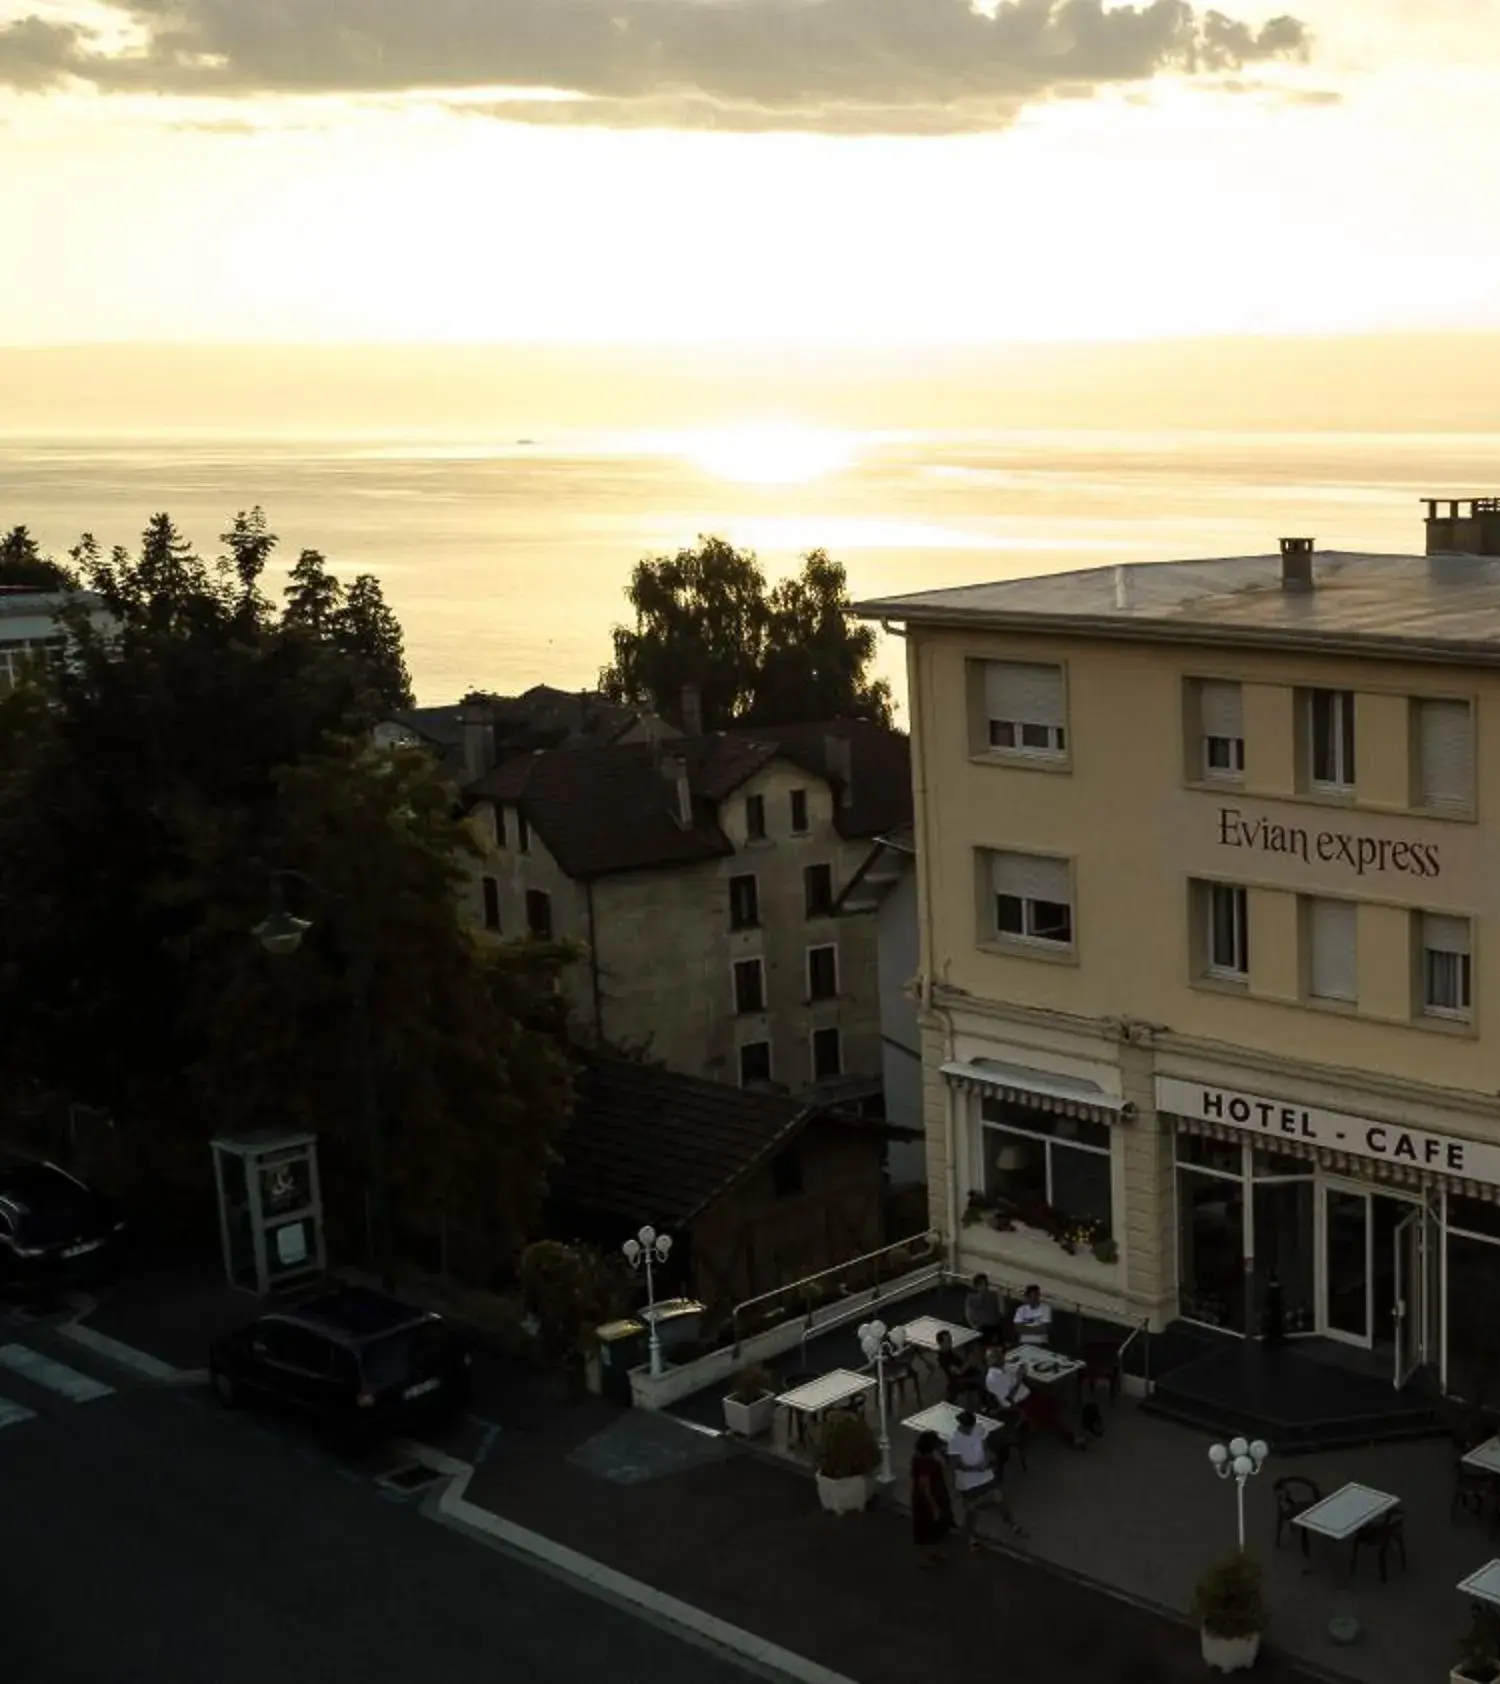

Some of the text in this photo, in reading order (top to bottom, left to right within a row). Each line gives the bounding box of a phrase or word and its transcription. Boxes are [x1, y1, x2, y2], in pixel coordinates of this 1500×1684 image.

[1217, 807, 1441, 877] Evian express
[1202, 1091, 1317, 1138] HOTEL
[1365, 1127, 1465, 1170] CAFE
